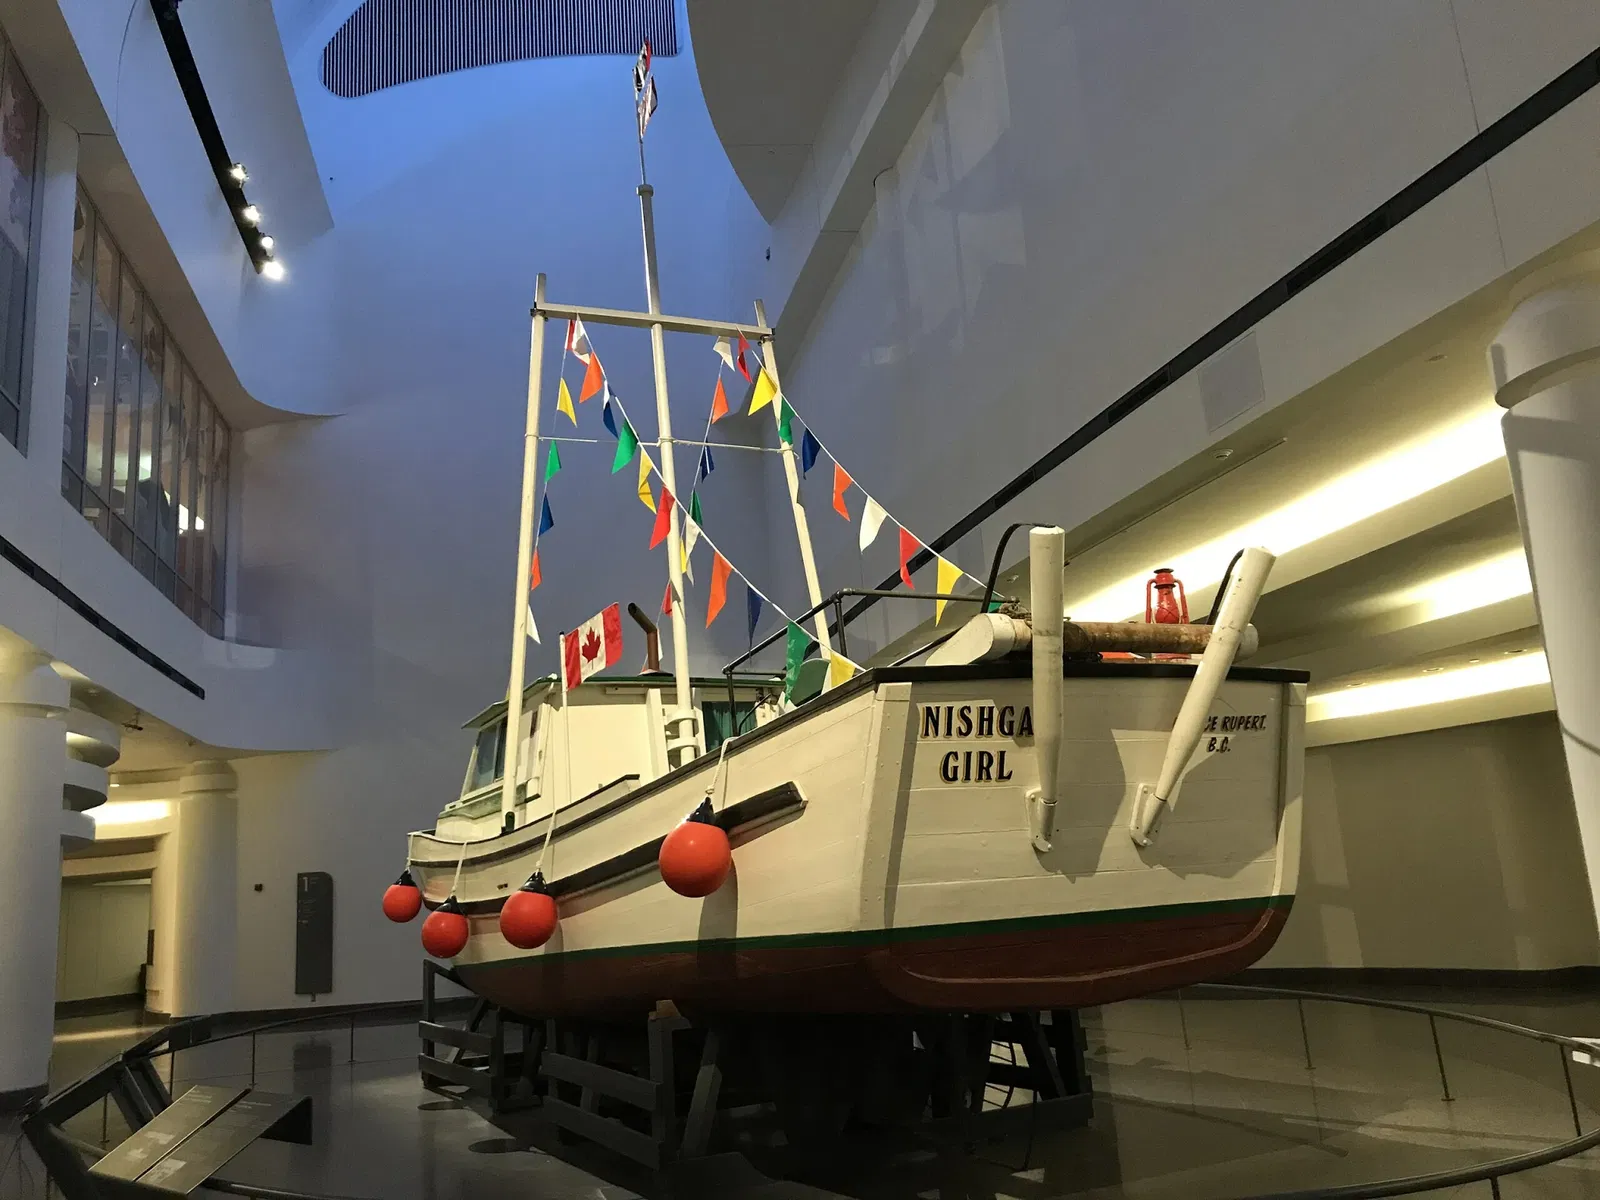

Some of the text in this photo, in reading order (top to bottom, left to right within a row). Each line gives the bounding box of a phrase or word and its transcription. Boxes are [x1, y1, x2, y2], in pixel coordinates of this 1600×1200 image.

[922, 705, 1034, 738] NISHGA
[1207, 737, 1231, 752] B.C.
[940, 751, 1013, 783] GIRL
